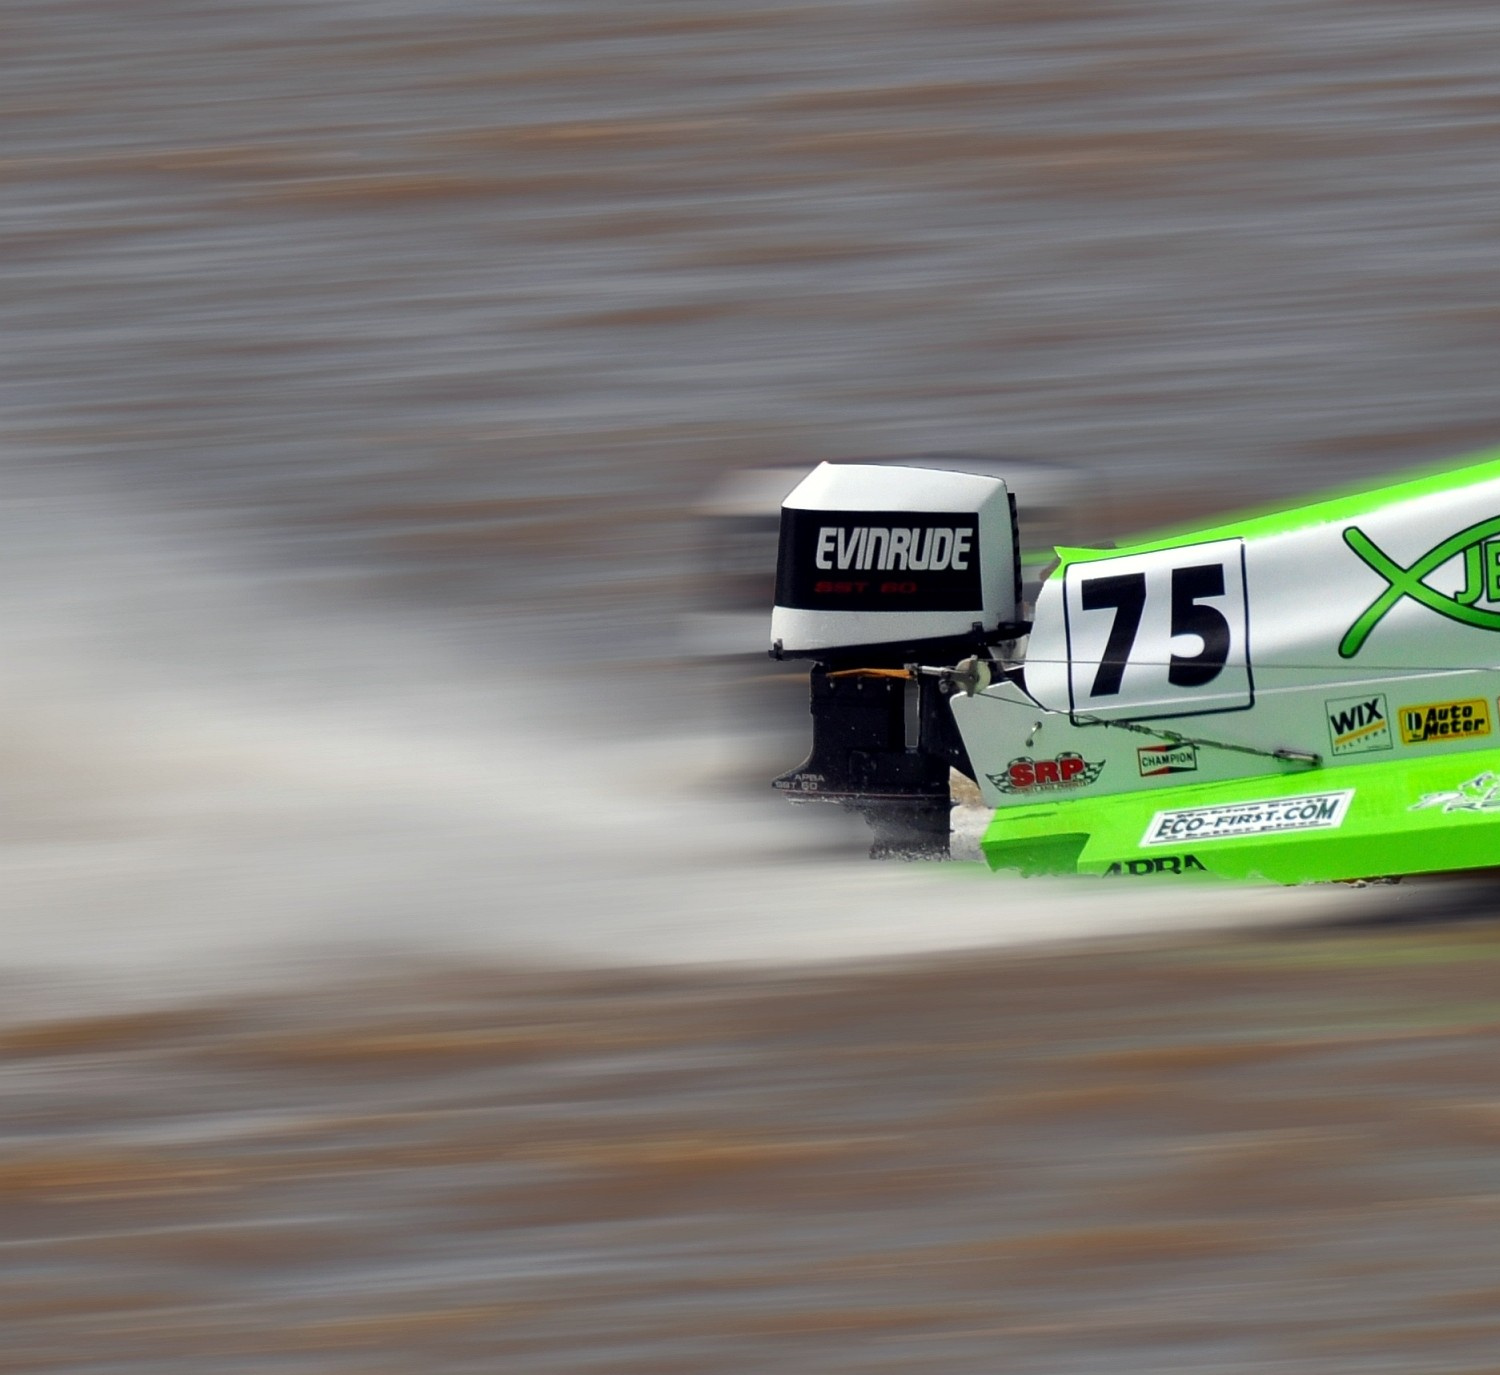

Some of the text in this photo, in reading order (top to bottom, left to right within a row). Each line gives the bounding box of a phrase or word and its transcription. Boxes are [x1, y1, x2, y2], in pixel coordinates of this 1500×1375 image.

[816, 527, 973, 570] EVINRUDE
[814, 581, 869, 593] SST
[1081, 563, 1231, 697] 75
[1330, 698, 1384, 735] WIX
[1423, 718, 1485, 740] Meter
[1425, 705, 1473, 722] Auto
[1009, 757, 1085, 789] SRP
[1141, 752, 1193, 767] CHAMPION
[1155, 799, 1340, 838] ECO-FIRST.COM
